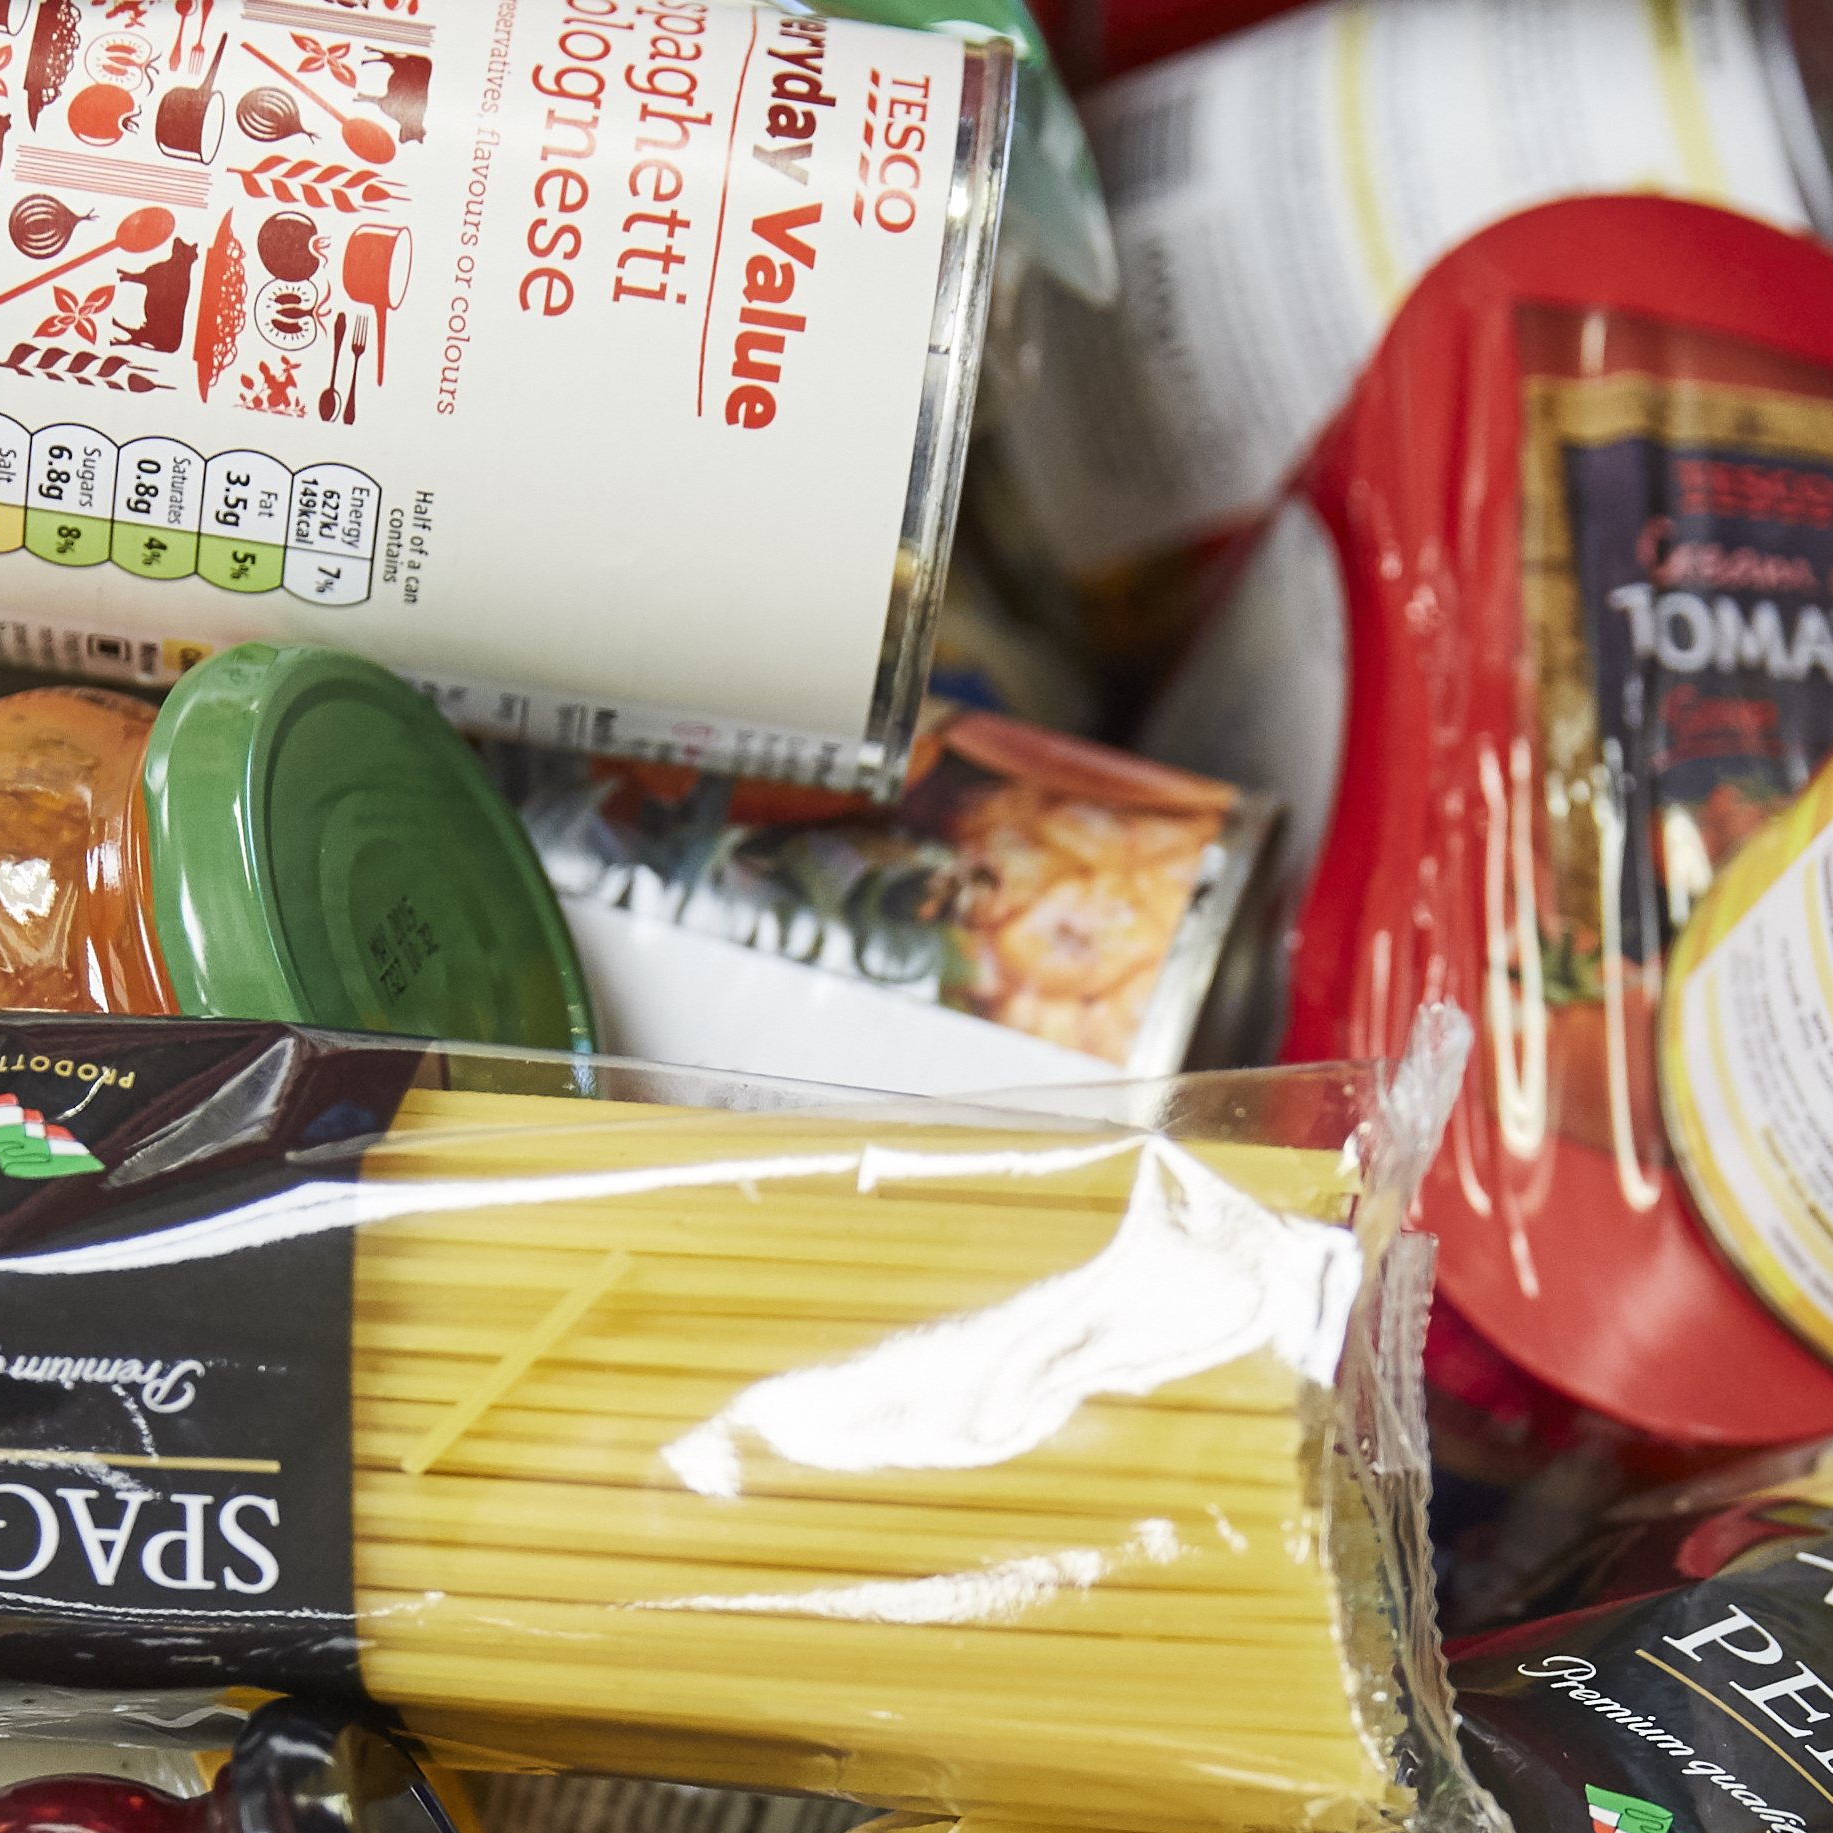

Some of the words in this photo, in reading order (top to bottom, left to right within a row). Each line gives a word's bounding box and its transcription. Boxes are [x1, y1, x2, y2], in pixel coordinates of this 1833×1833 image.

[519, 0, 634, 316] olognese
[875, 75, 931, 233] TESCO
[460, 131, 501, 247] flavours
[455, 255, 476, 289] or
[725, 202, 823, 429] Value
[436, 297, 471, 415] colours
[38, 445, 72, 500] 6.8g
[77, 447, 102, 508] Sugars
[127, 458, 161, 515] 0.8g
[168, 457, 191, 525] Saturates
[216, 470, 251, 527] 3.5g
[258, 490, 278, 518] Fat
[295, 477, 319, 545] 149kcal
[320, 490, 341, 540] 627kJ
[343, 485, 370, 549] Energy
[416, 490, 434, 532] Half
[56, 525, 81, 553] 8%
[142, 536, 168, 566] 4%
[230, 550, 257, 581] 5%
[384, 508, 404, 584] contains
[411, 538, 429, 560] of
[315, 566, 342, 594] 7%
[404, 576, 421, 605] can
[5, 1343, 208, 1413] Premium
[1517, 1654, 1695, 1758] Premium
